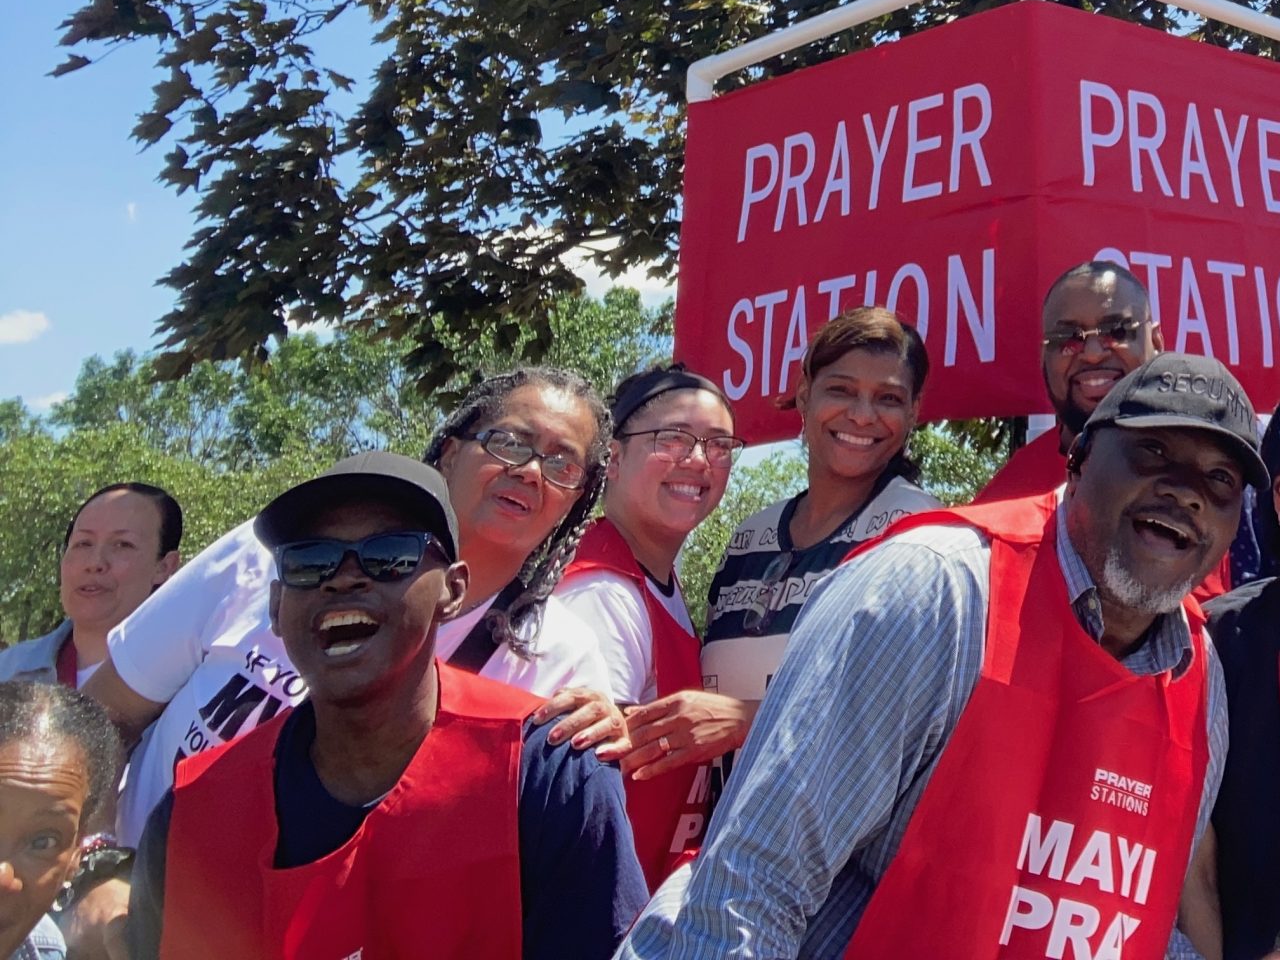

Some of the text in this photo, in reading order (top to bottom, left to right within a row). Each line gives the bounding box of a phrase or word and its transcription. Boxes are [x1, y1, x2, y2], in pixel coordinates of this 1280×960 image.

[737, 83, 992, 243] PRAYER
[245, 649, 306, 698] IF YO
[1090, 785, 1149, 817] STATIONS
[1094, 768, 1152, 798] PRAYER
[1016, 812, 1157, 905] MAY I
